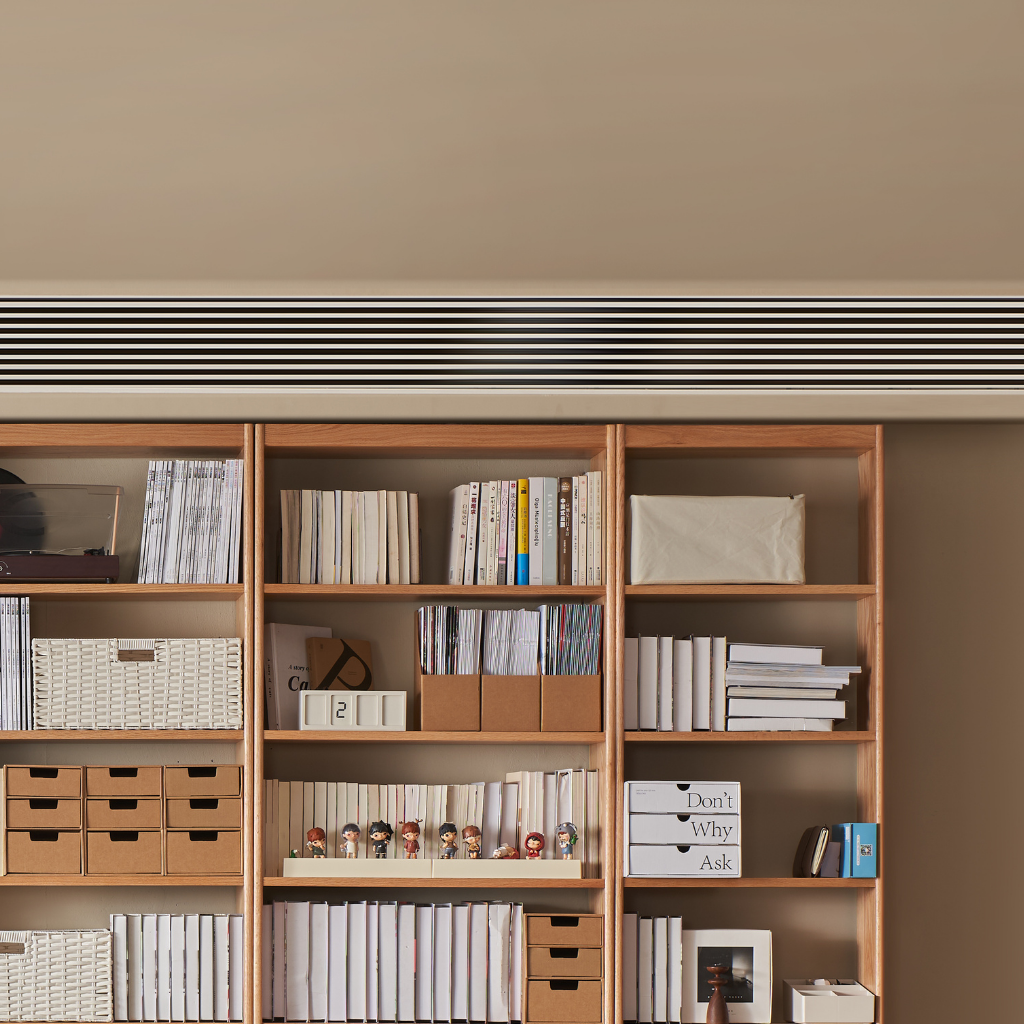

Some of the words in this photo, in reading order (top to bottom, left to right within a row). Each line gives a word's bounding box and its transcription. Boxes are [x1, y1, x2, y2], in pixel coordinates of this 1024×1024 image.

[336, 702, 346, 718] 2
[687, 792, 733, 808] Don't
[691, 821, 733, 842] Why
[700, 854, 733, 870] Ask
